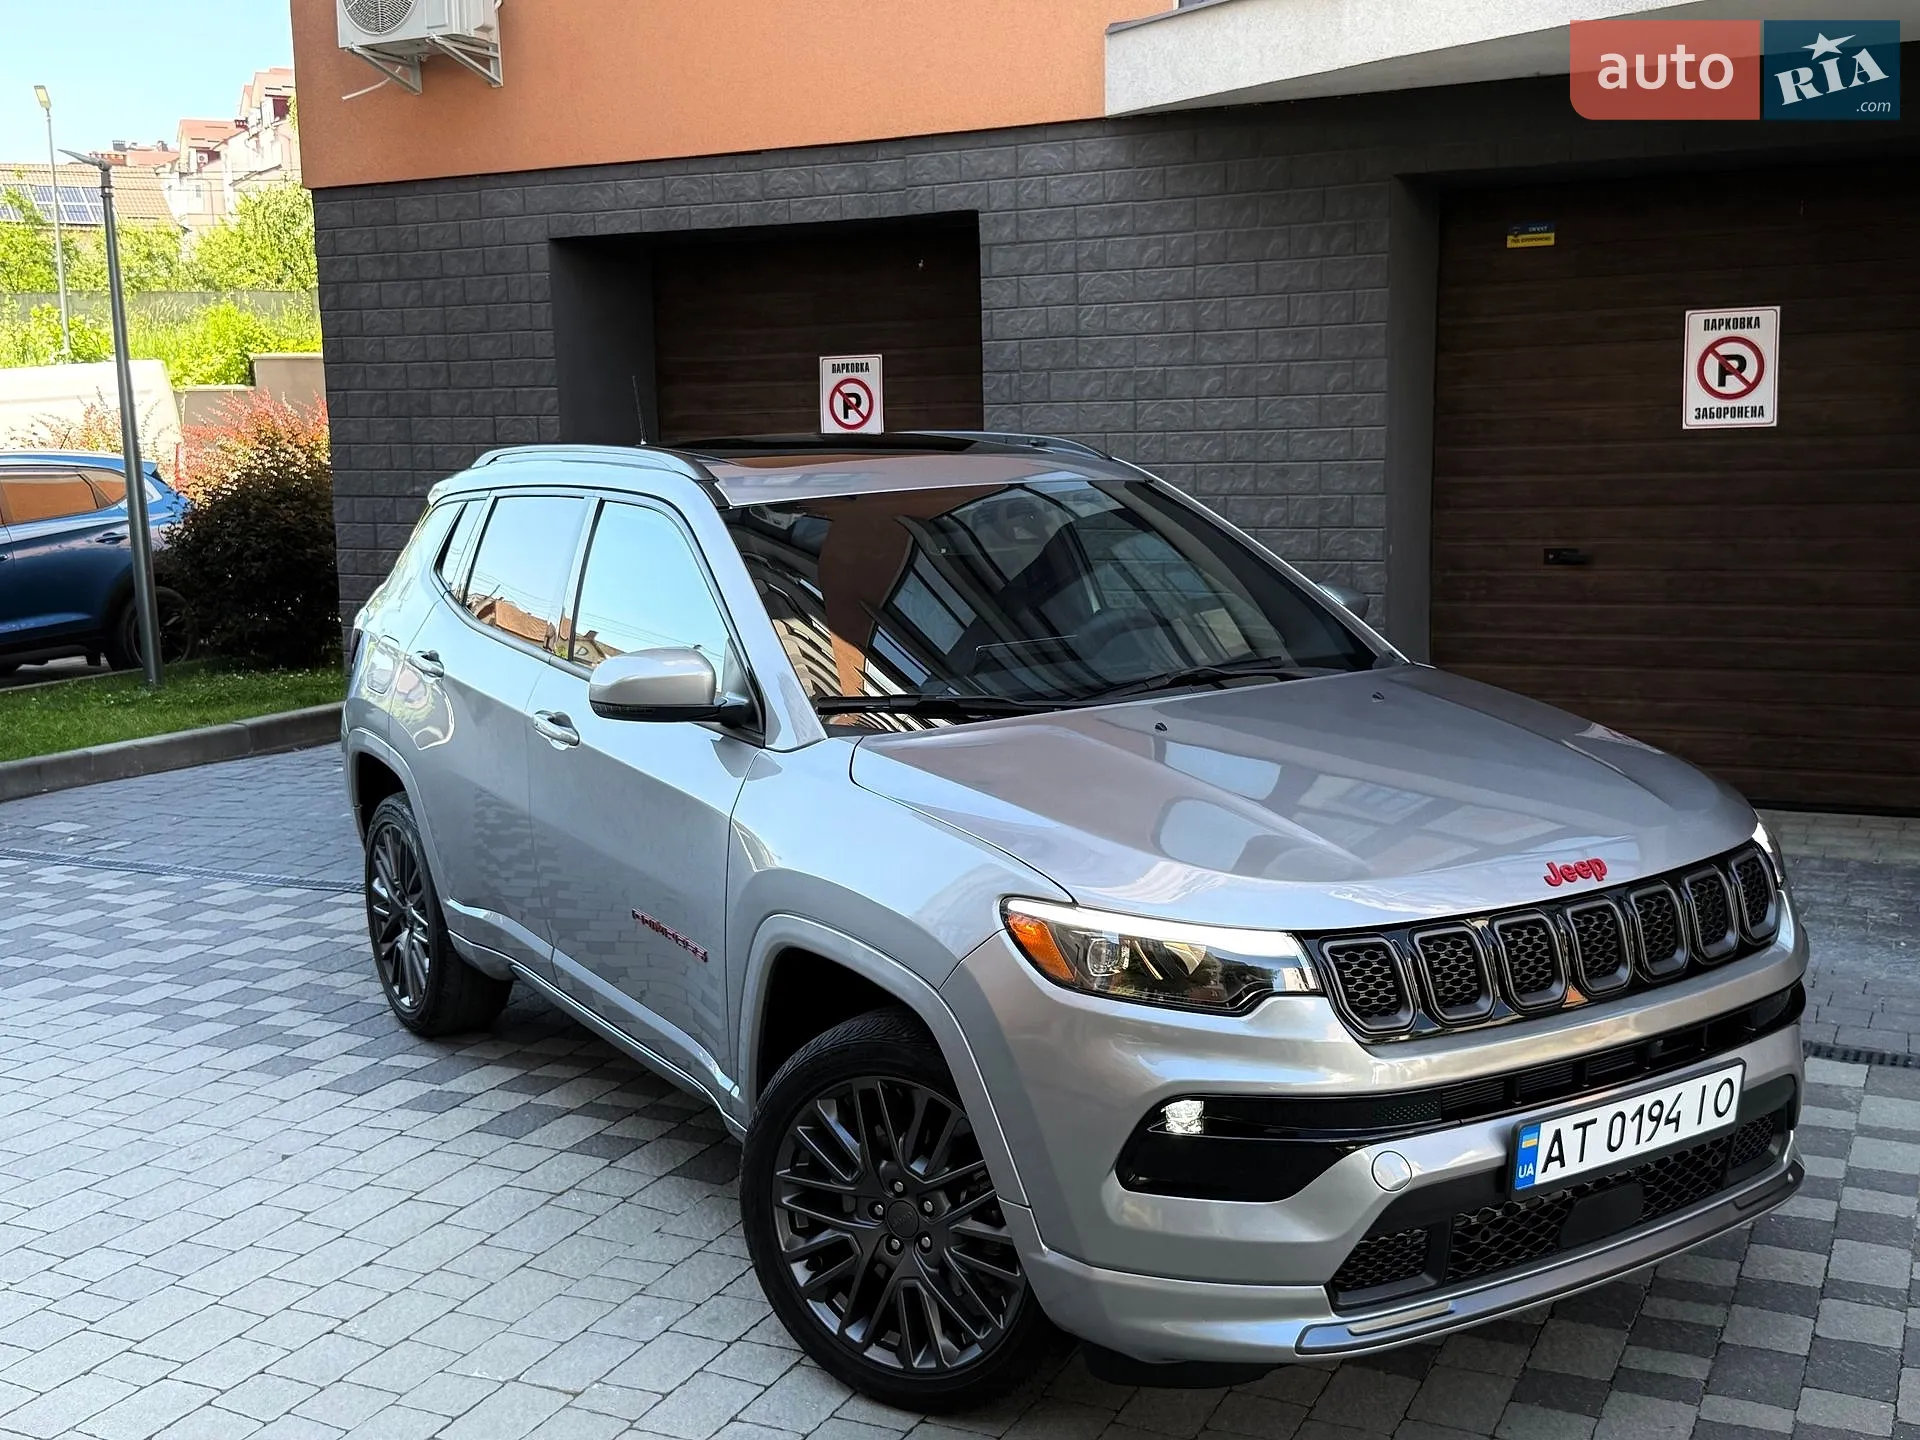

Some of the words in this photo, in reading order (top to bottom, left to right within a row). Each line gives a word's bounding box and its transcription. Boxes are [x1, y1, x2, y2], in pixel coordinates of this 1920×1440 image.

[1703, 316, 1761, 332] ПАРКОВКА
[831, 362, 870, 374] ПАРКОВКА
[1694, 405, 1765, 420] ЗАБОРОНЕНА
[1543, 858, 1608, 887] Jeep
[1540, 1117, 1598, 1174] AT
[1606, 1091, 1683, 1153] 0194
[1518, 1163, 1535, 1179] UA
